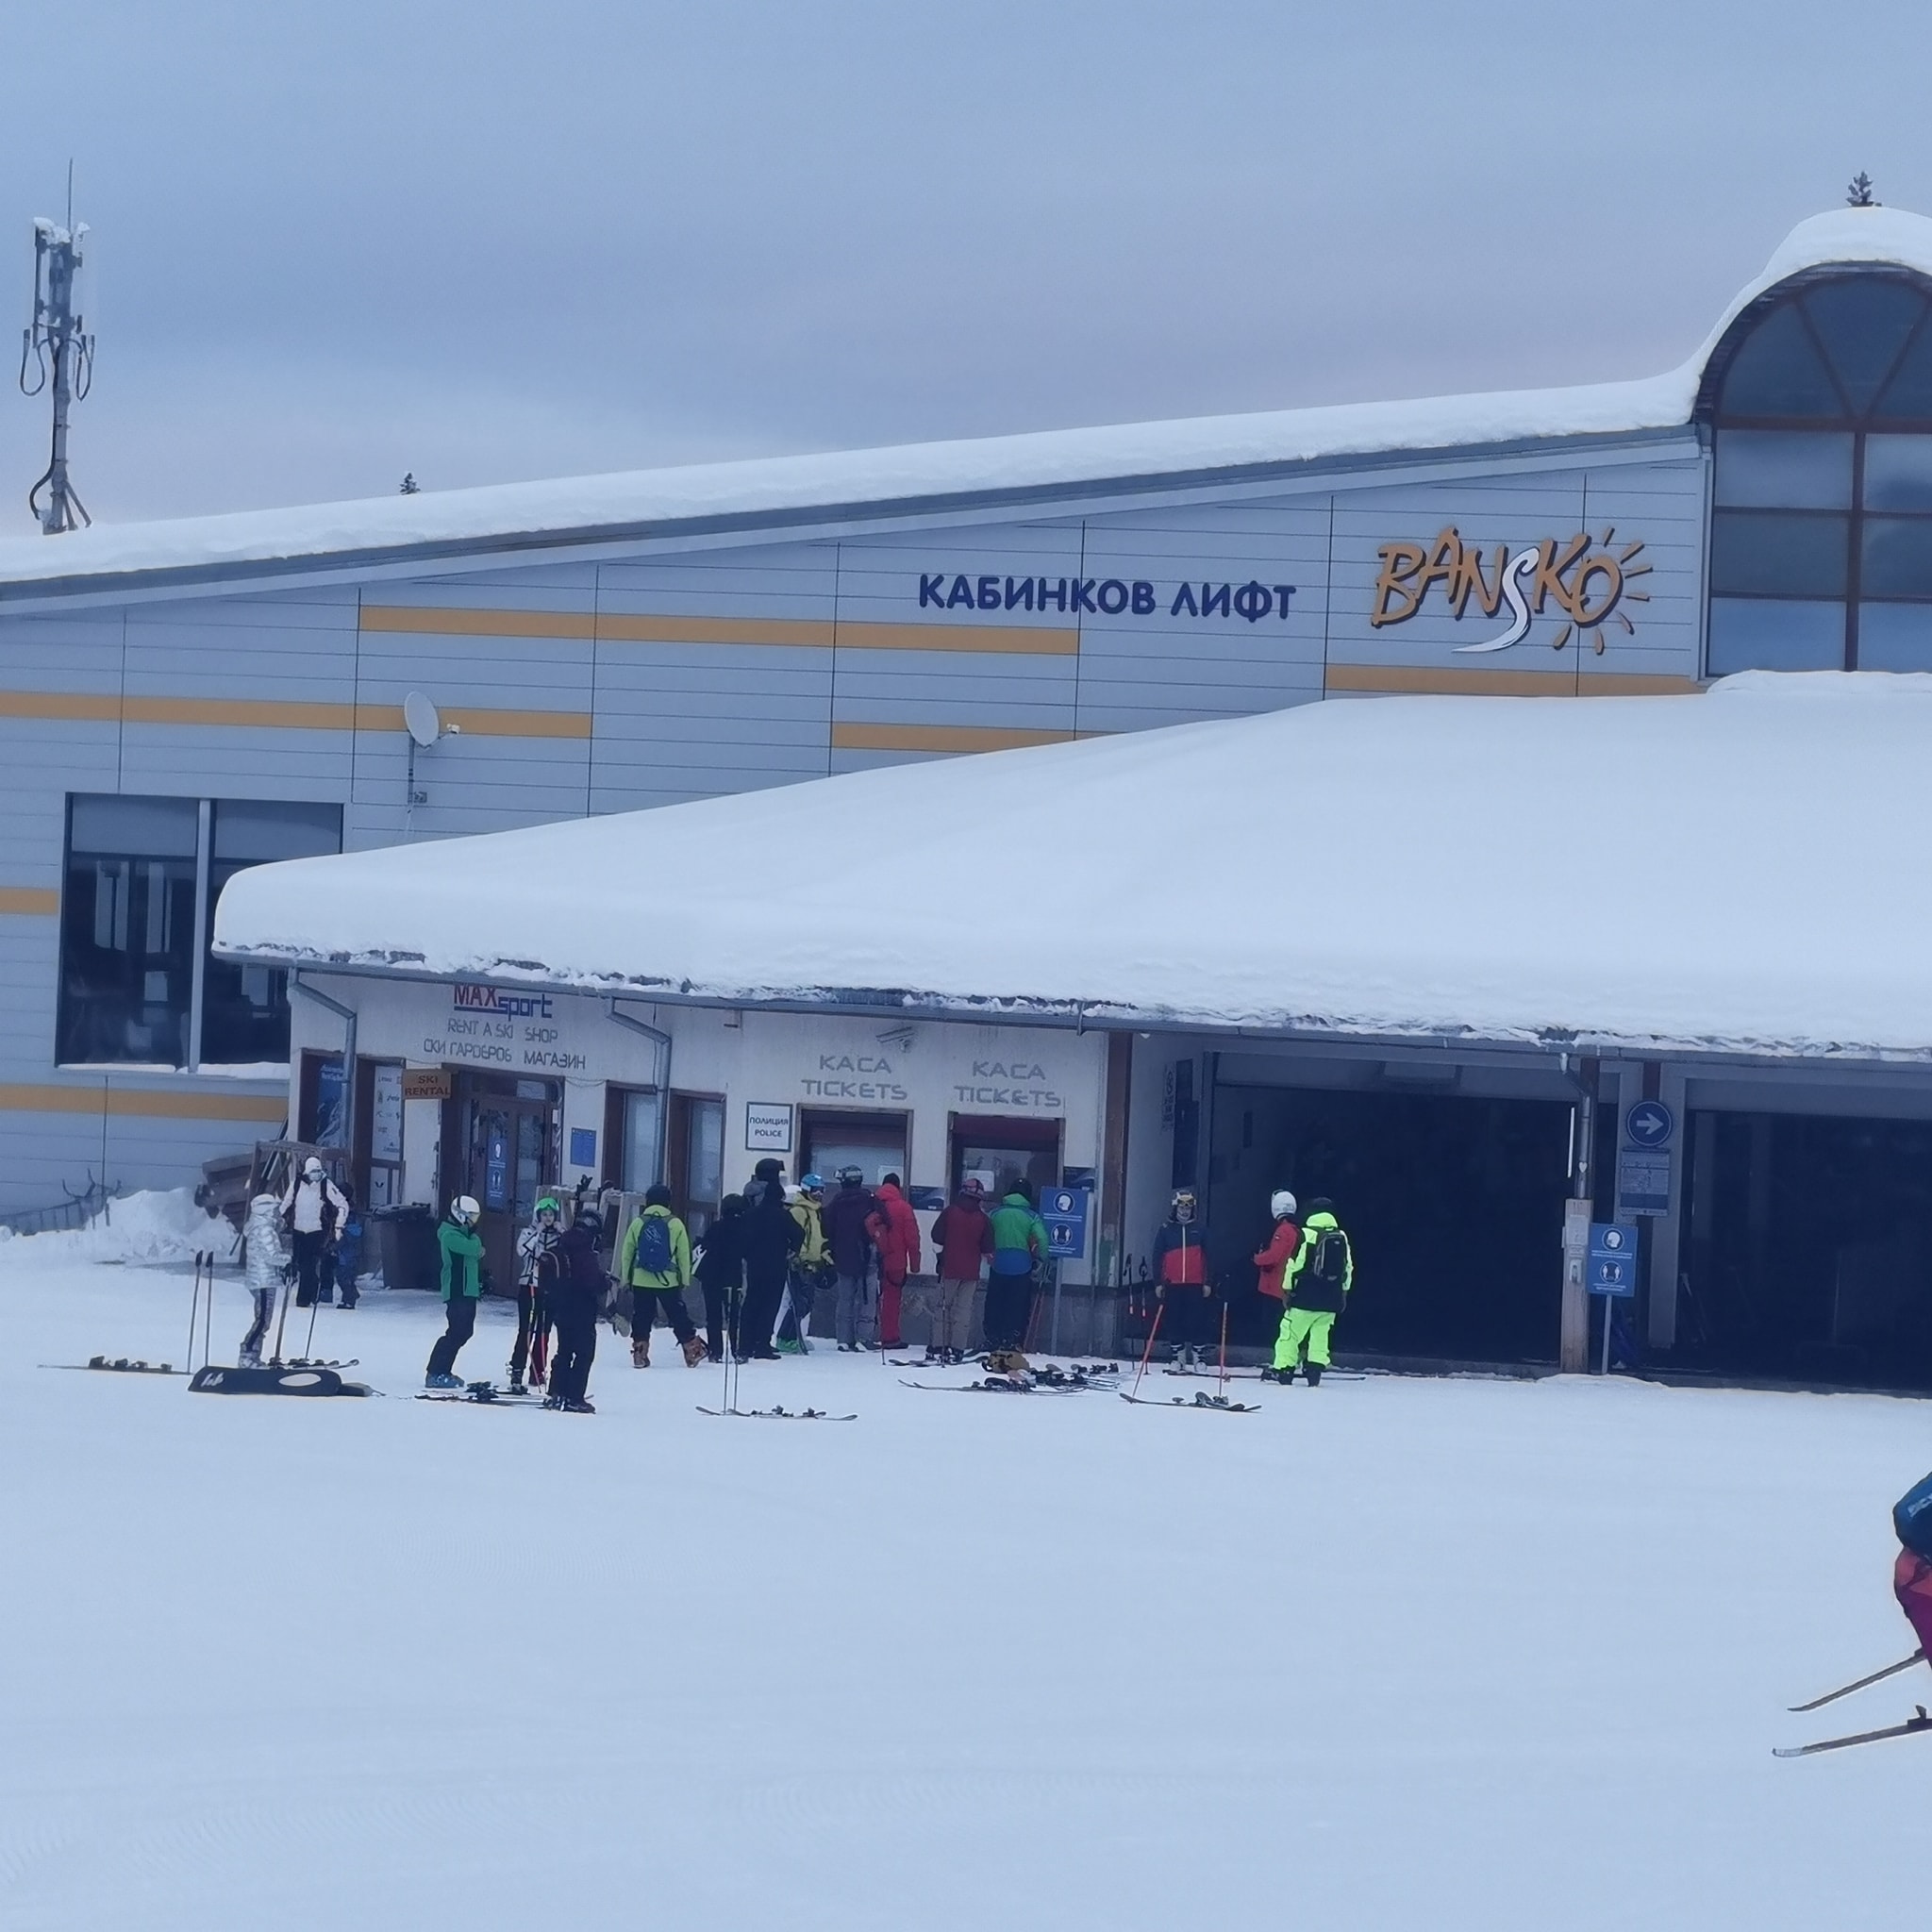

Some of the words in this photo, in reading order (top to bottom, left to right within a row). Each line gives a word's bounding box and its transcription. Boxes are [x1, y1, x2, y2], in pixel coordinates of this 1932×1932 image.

[919, 574, 1157, 615] КАБИНКОВ
[1170, 579, 1297, 624] ЛИФТ
[1372, 525, 1624, 654] BANSKO
[447, 1018, 479, 1036] RENT
[483, 1022, 492, 1037] A
[495, 1023, 513, 1040] SKI
[525, 1026, 558, 1043] SHOP
[424, 1038, 446, 1055] СКИ
[524, 1050, 586, 1070] МАГАЗИН
[819, 1055, 891, 1074] КАСА
[418, 1075, 439, 1084] SKI
[972, 1060, 1046, 1080] КАСА
[405, 1087, 450, 1096] RENTAL
[801, 1079, 908, 1101] TICKETS
[954, 1085, 1061, 1108] TICKETS
[749, 1116, 789, 1126] ПОЛИЦИЯ
[755, 1128, 782, 1138] POLICE
